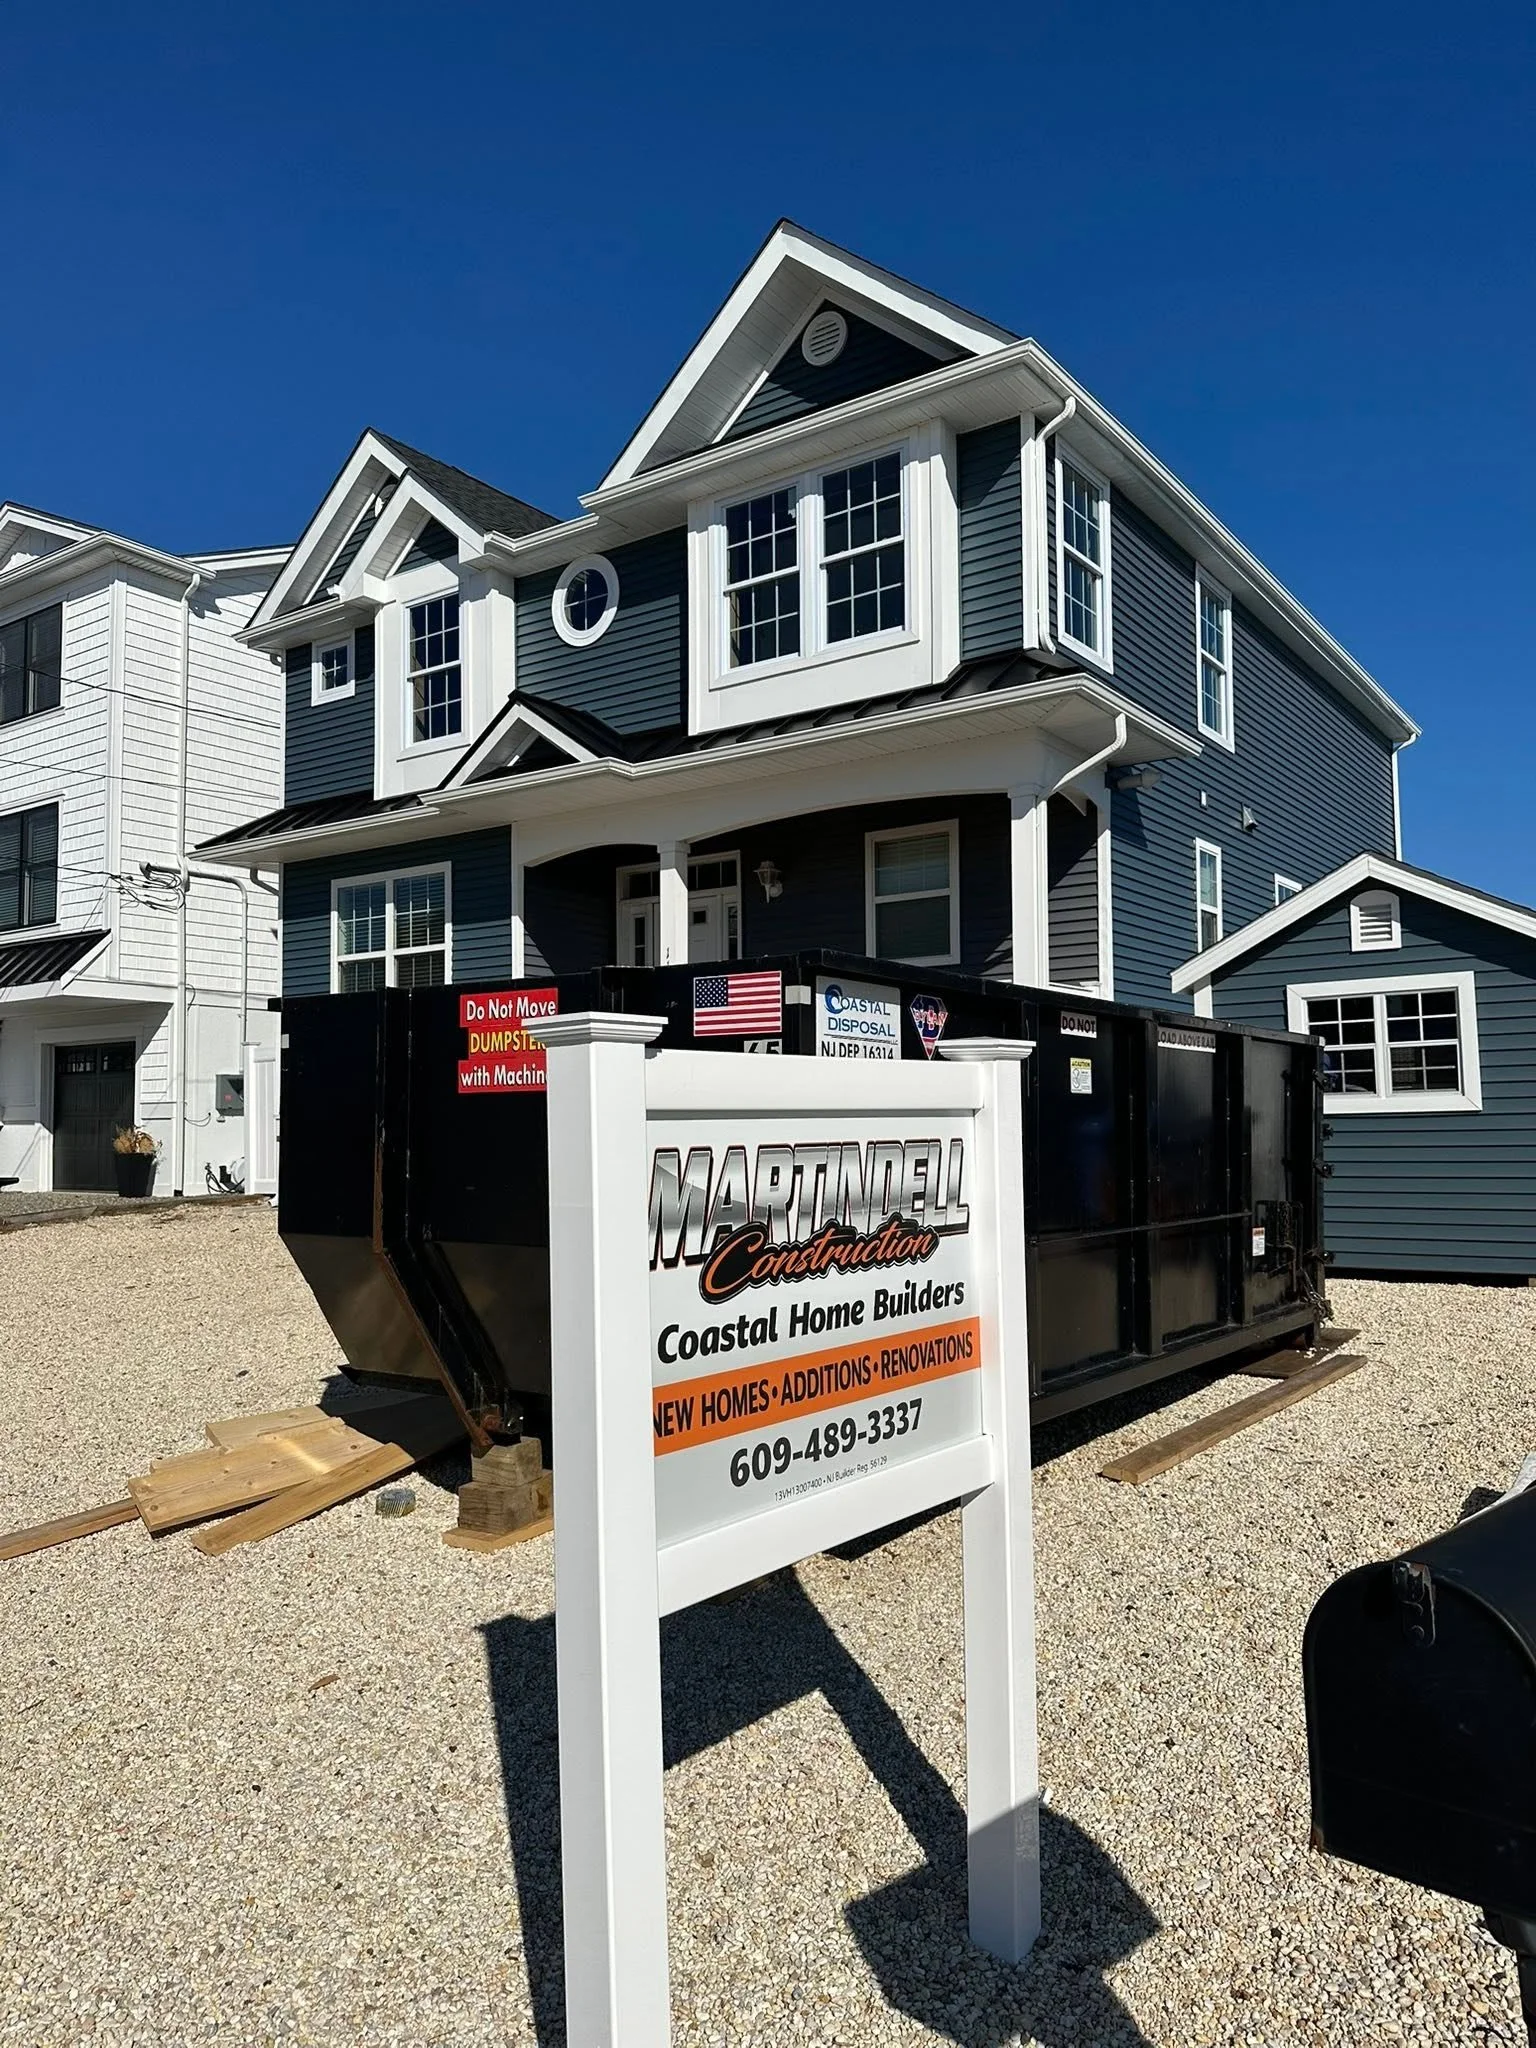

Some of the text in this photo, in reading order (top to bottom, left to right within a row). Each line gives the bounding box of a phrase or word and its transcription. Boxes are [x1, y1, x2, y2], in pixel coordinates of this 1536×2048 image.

[466, 996, 556, 1021] Do Not Move
[824, 984, 891, 1016] COASTAL
[828, 1017, 896, 1037] DISPOSAL
[1062, 1016, 1095, 1034] DO NOT
[821, 1040, 894, 1059] NJ DEP 16314
[461, 1063, 546, 1086] with Machin
[648, 1137, 970, 1272] MARTINDELL
[702, 1217, 938, 1299] Construction
[657, 1280, 965, 1364] Coastal Home Builders
[653, 1331, 974, 1438] NEW HOMES ADDITIONS RENOVATIONS
[729, 1398, 923, 1487] 609-489-3337
[835, 1468, 856, 1482] Builder
[870, 1455, 888, 1470] 56129
